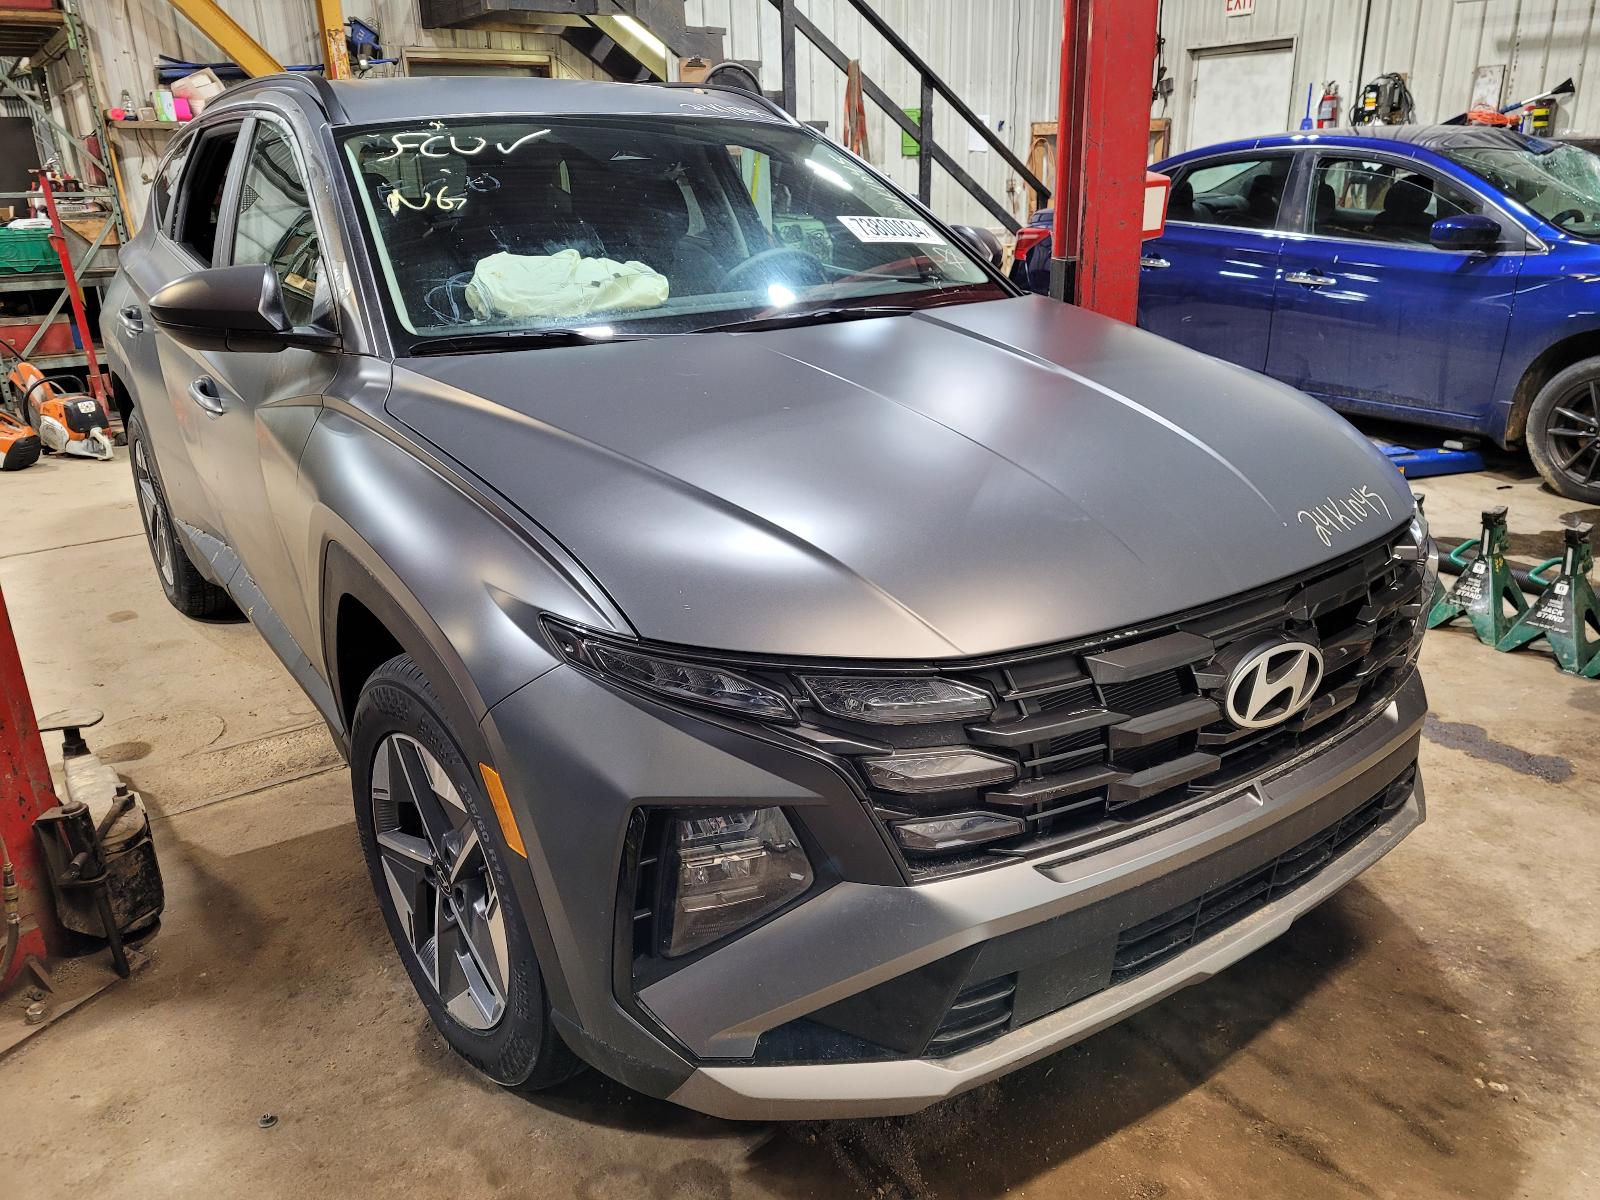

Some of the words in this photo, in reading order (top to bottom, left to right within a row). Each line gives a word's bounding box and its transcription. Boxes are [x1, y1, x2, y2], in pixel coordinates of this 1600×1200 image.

[1455, 589, 1483, 601] STAND
[1460, 584, 1482, 594] JACK
[1535, 611, 1566, 623] STAND
[1541, 605, 1565, 617] JACK
